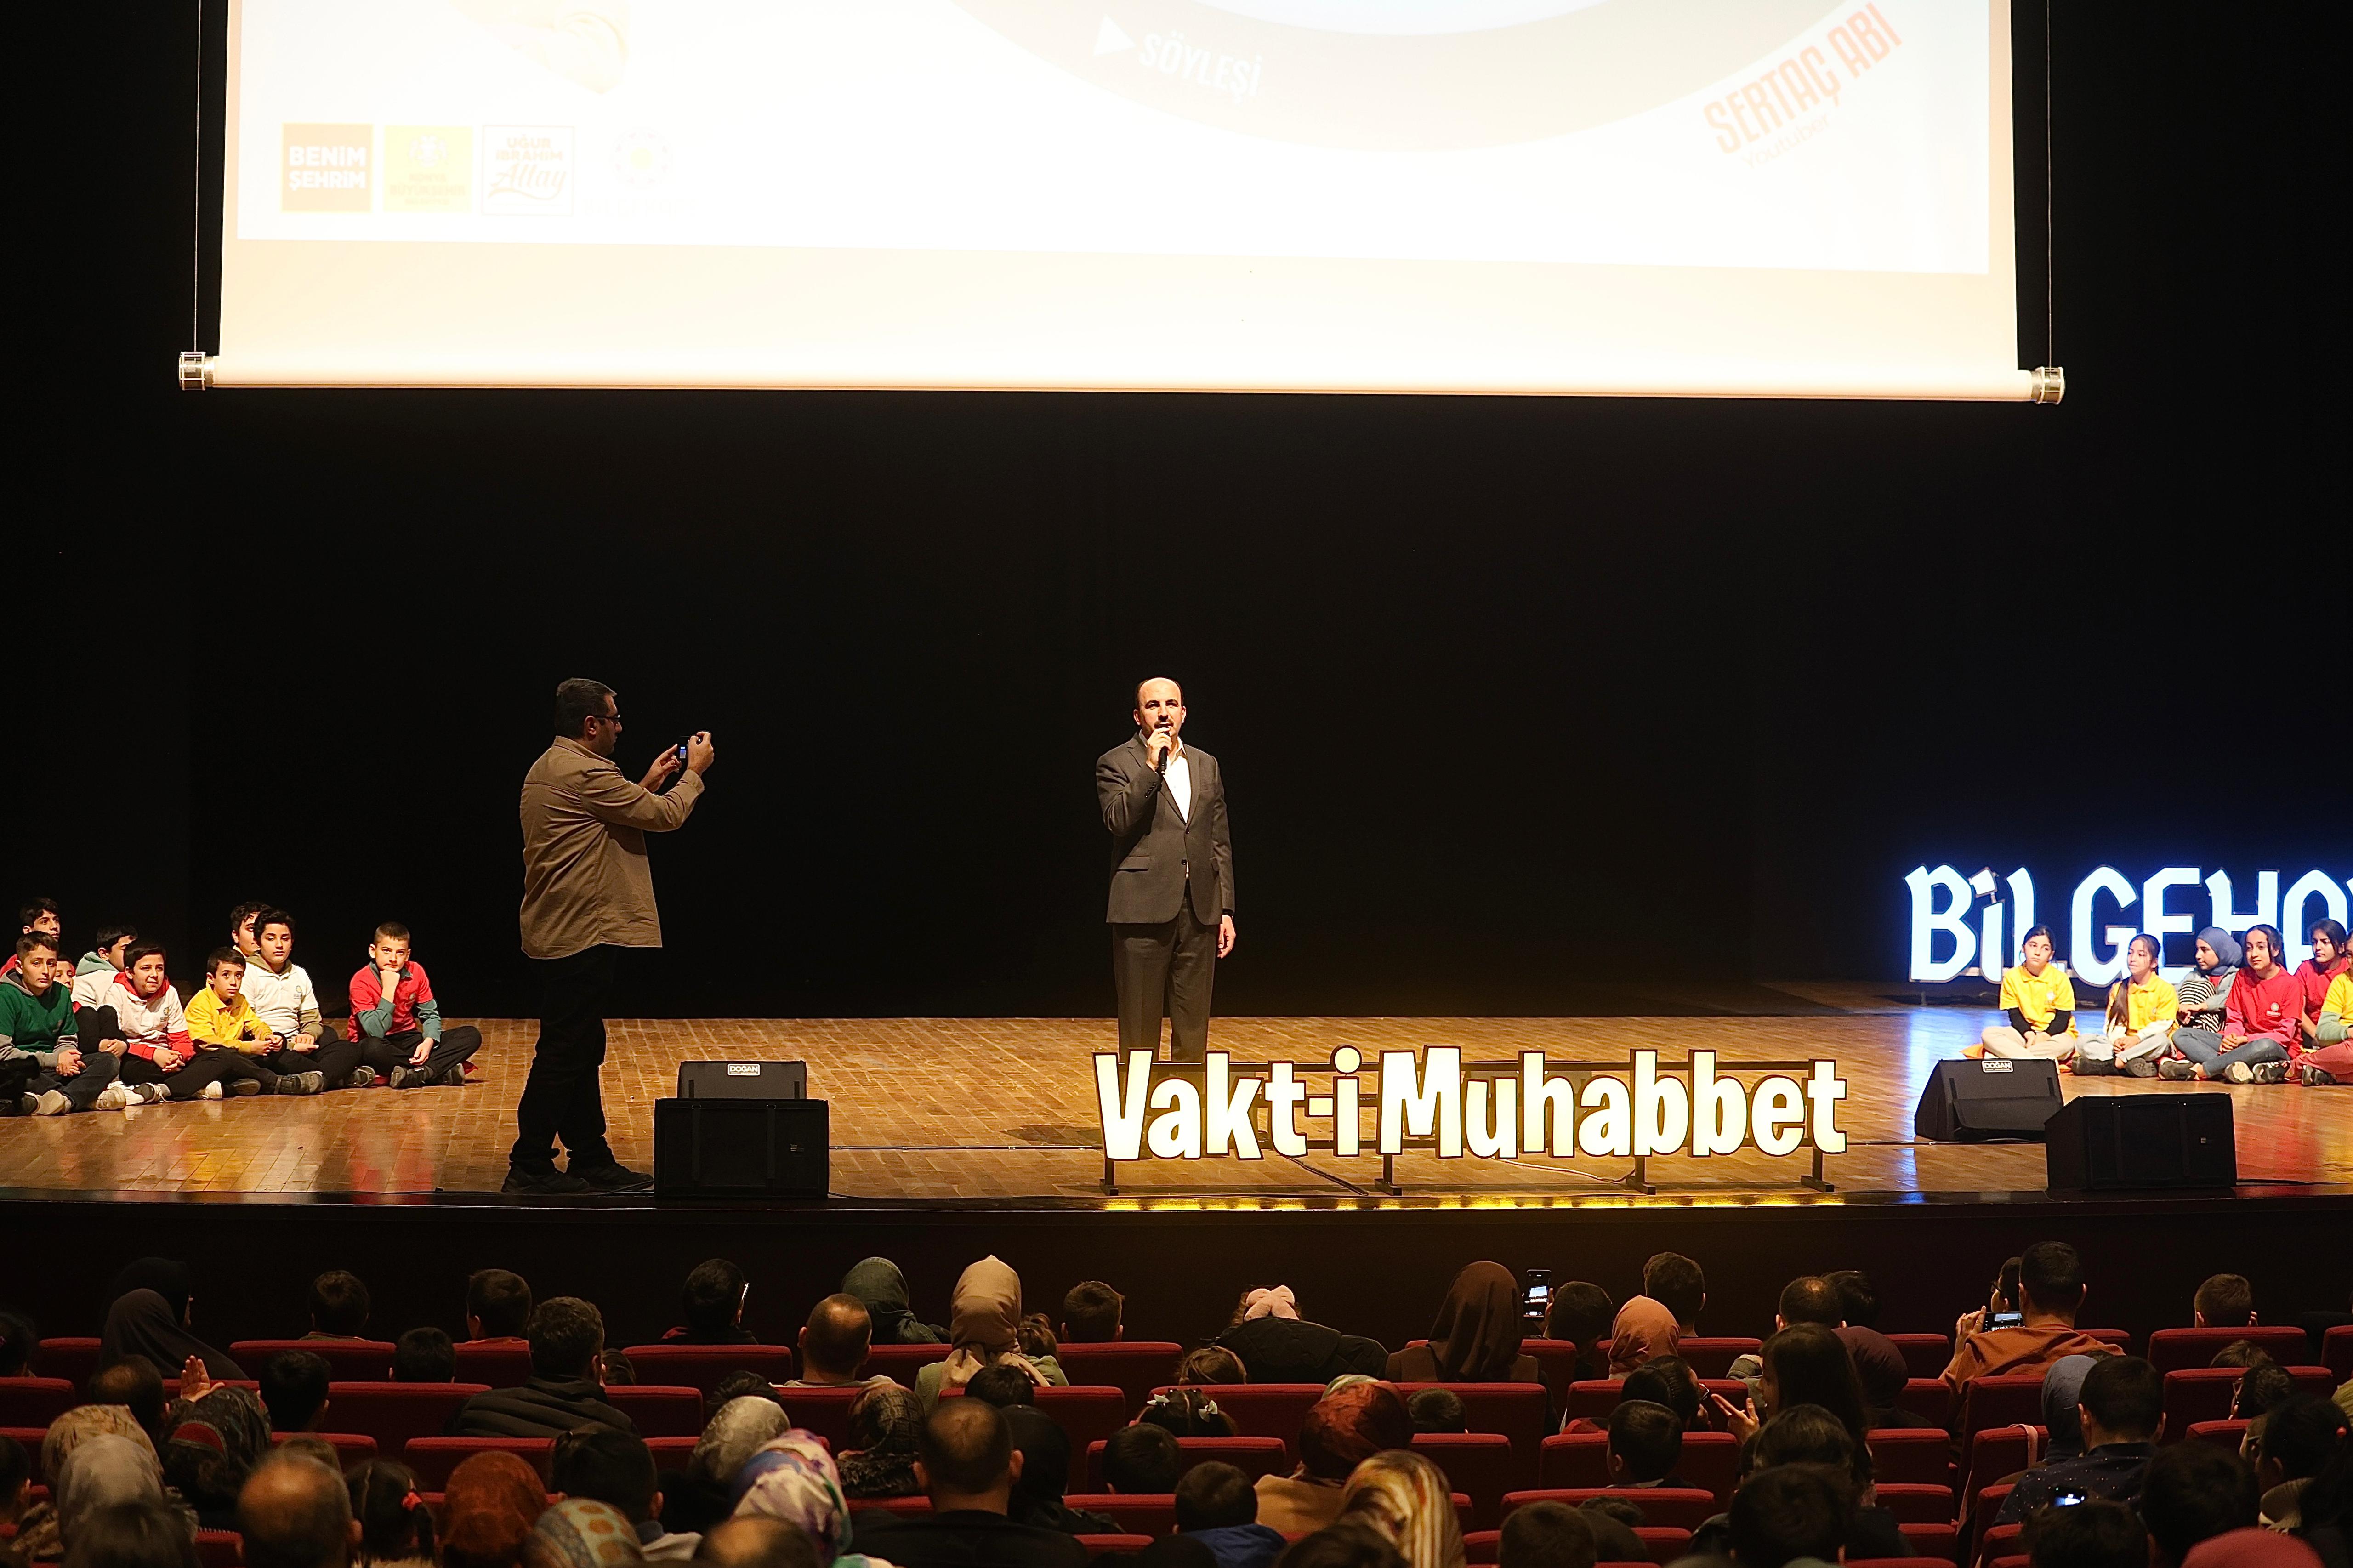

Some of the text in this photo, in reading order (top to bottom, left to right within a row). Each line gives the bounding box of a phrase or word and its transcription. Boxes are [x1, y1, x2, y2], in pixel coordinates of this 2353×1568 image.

[1703, 46, 1841, 154] SERTAÇ
[1093, 1045, 1848, 1160] Vakt-i Muhabbet
